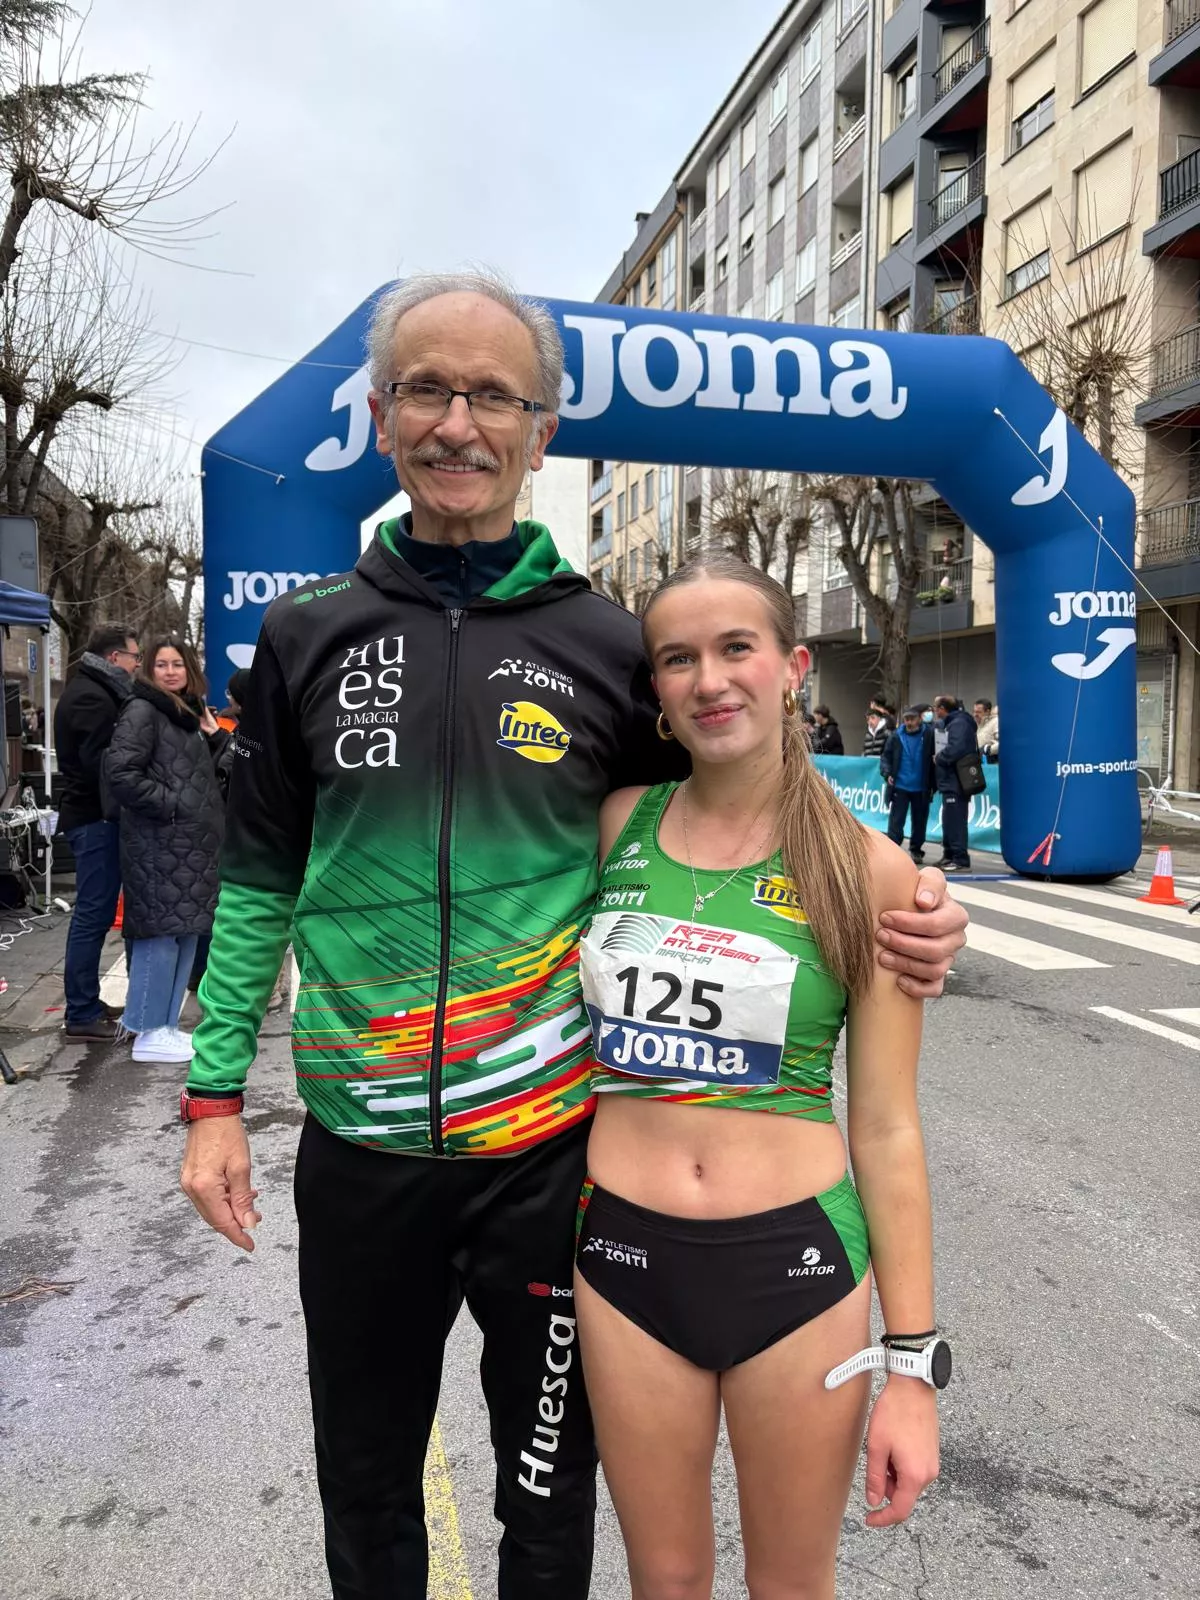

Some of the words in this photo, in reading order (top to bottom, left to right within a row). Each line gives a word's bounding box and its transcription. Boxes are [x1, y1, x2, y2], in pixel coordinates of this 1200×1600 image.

[558, 314, 908, 420] Joma
[223, 571, 341, 611] Jom
[315, 579, 352, 597] barri
[1048, 590, 1137, 626] Joma
[523, 668, 575, 698] ZOITI
[525, 661, 573, 684] ATLETISMO
[338, 667, 403, 710] es
[502, 714, 570, 747] Intec
[335, 728, 400, 769] ca
[1056, 759, 1138, 777] joma-sport.co
[605, 859, 650, 875] VIATOR
[608, 883, 651, 891] ATLETISMO
[758, 883, 802, 904] Int
[672, 924, 737, 944] RFEA
[655, 948, 713, 965] MARCHA
[663, 937, 761, 964] ATLETISMO
[615, 965, 724, 1031] 125
[612, 1026, 749, 1075] Joma
[604, 1239, 648, 1256] ATLETISMO
[604, 1247, 648, 1269] ZOITI
[787, 1264, 836, 1277] VIATOR
[551, 1285, 576, 1298] bar
[517, 1313, 577, 1498] Huesca
